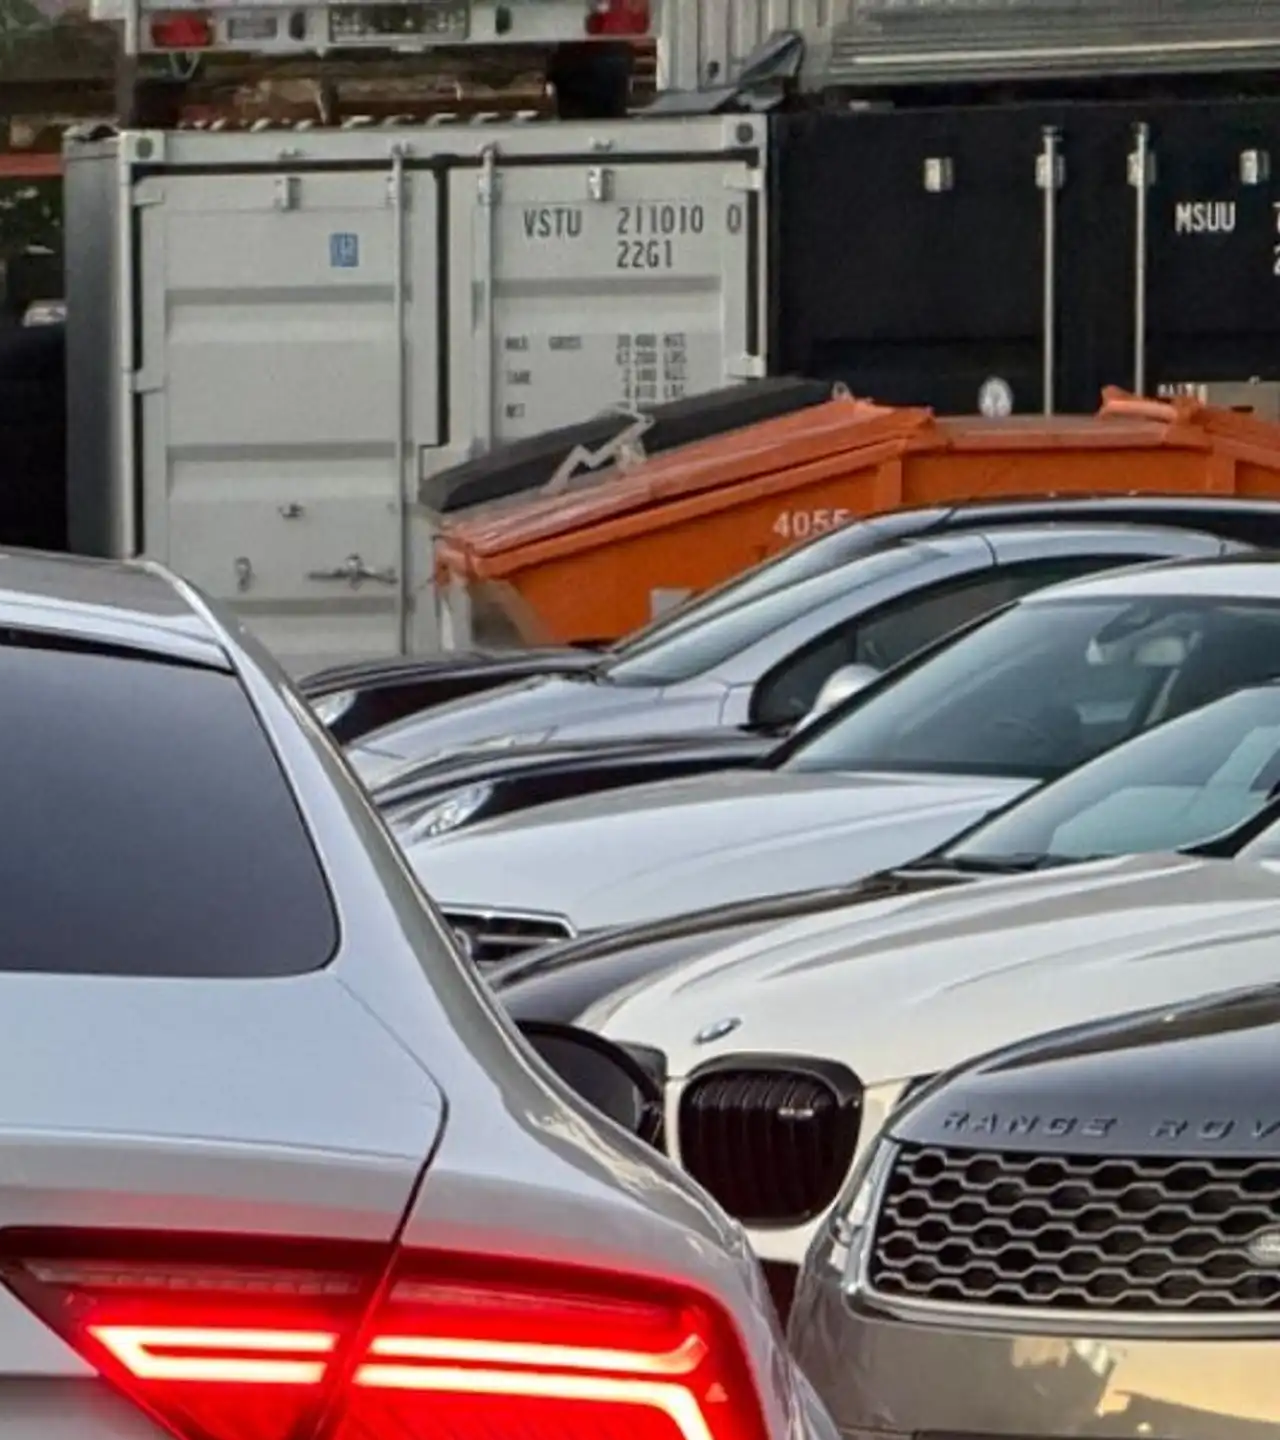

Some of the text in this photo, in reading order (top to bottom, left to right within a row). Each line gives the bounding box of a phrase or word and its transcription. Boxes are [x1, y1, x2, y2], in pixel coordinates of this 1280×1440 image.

[523, 203, 742, 237] VSTU 211010 0
[1175, 200, 1236, 232] MSUU
[616, 239, 672, 268] 22G1
[943, 1111, 1117, 1139] RANGE
